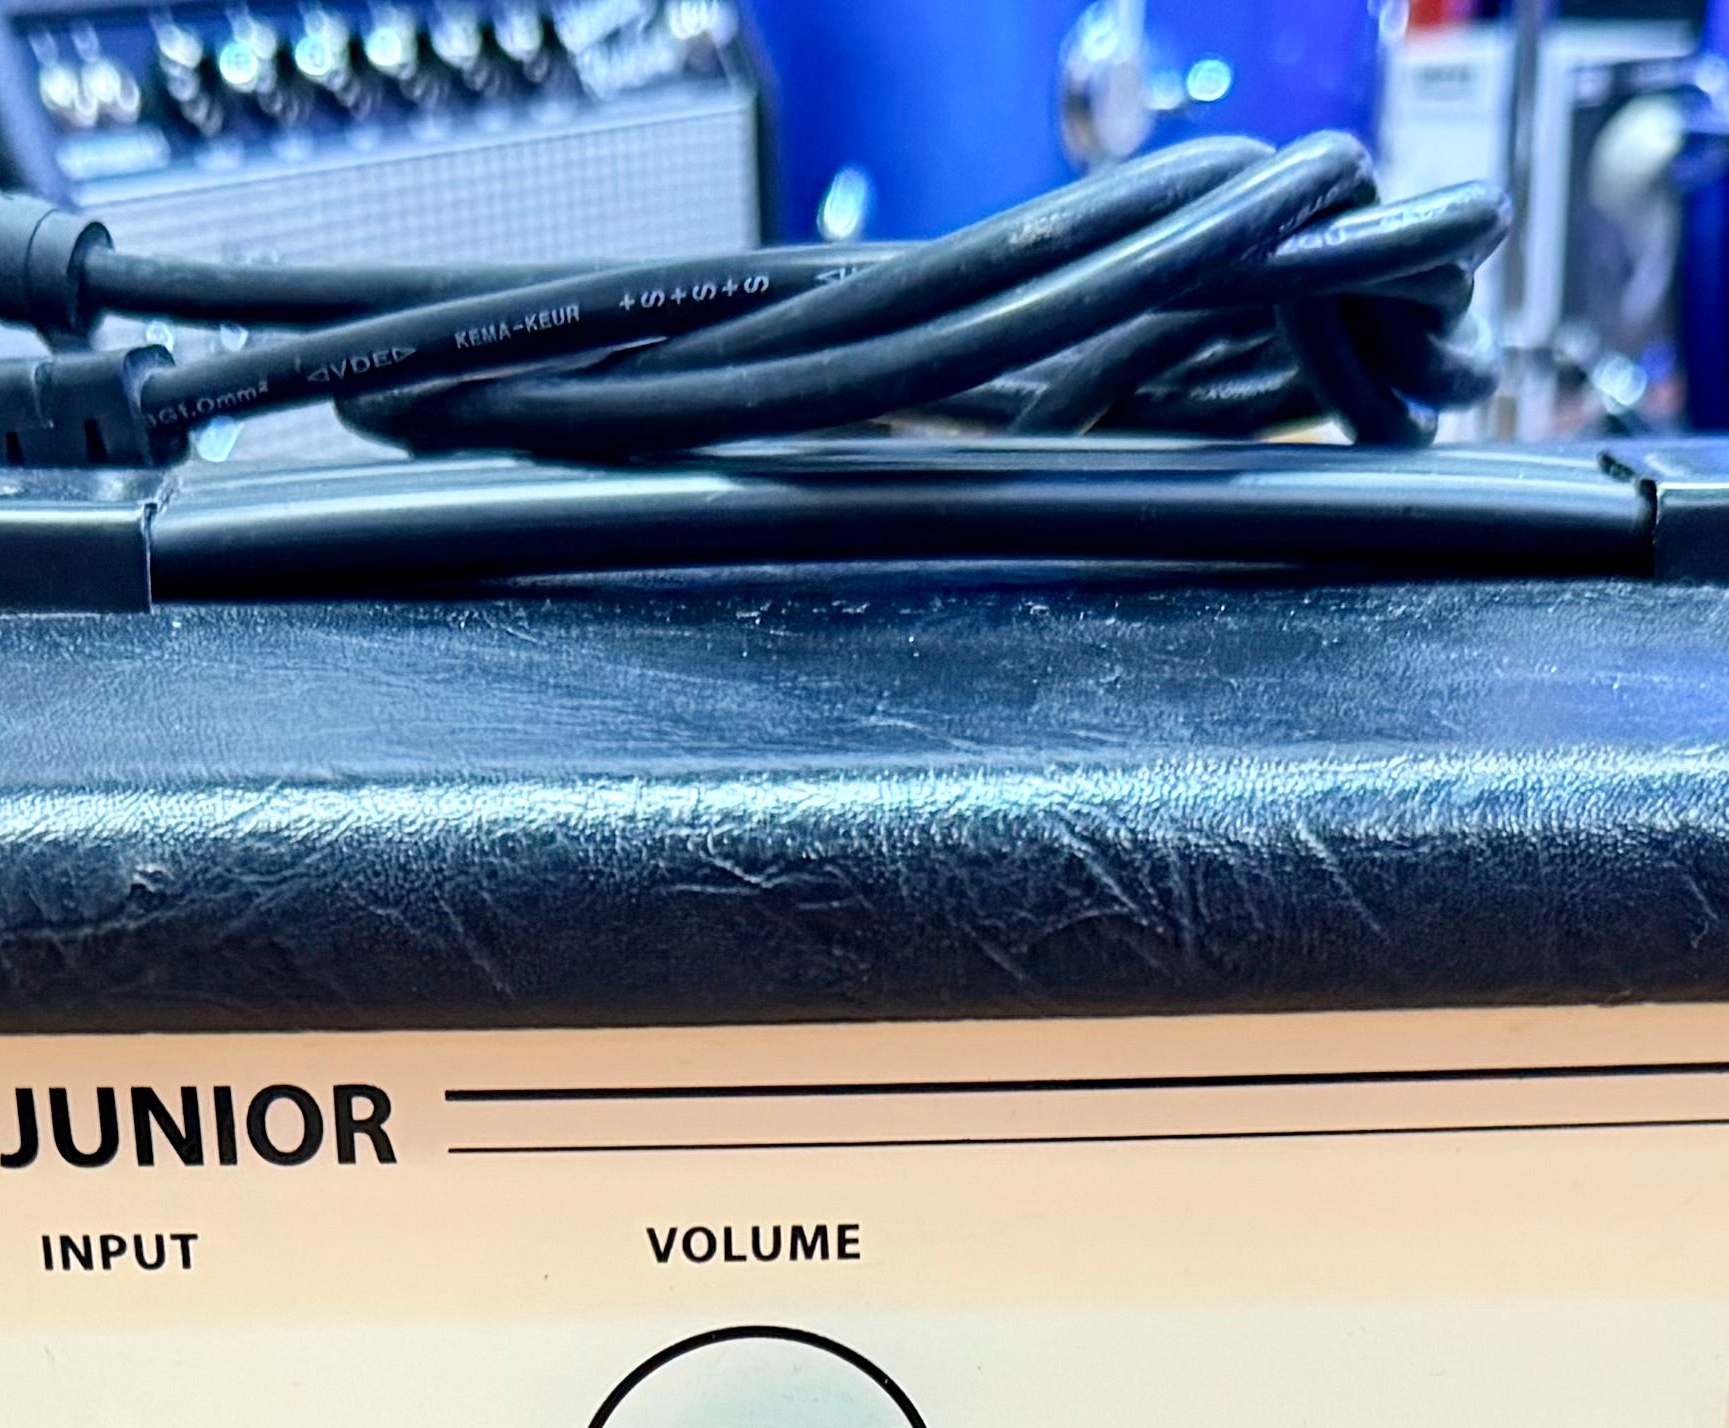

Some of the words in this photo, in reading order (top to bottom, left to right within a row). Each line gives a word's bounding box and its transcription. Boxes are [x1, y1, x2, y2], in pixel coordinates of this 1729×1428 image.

[454, 305, 580, 350] KEMA-KEUR
[0, 1083, 397, 1169] JUNIOR
[41, 1233, 199, 1271] INPUT
[646, 1223, 862, 1264] VOLUME
